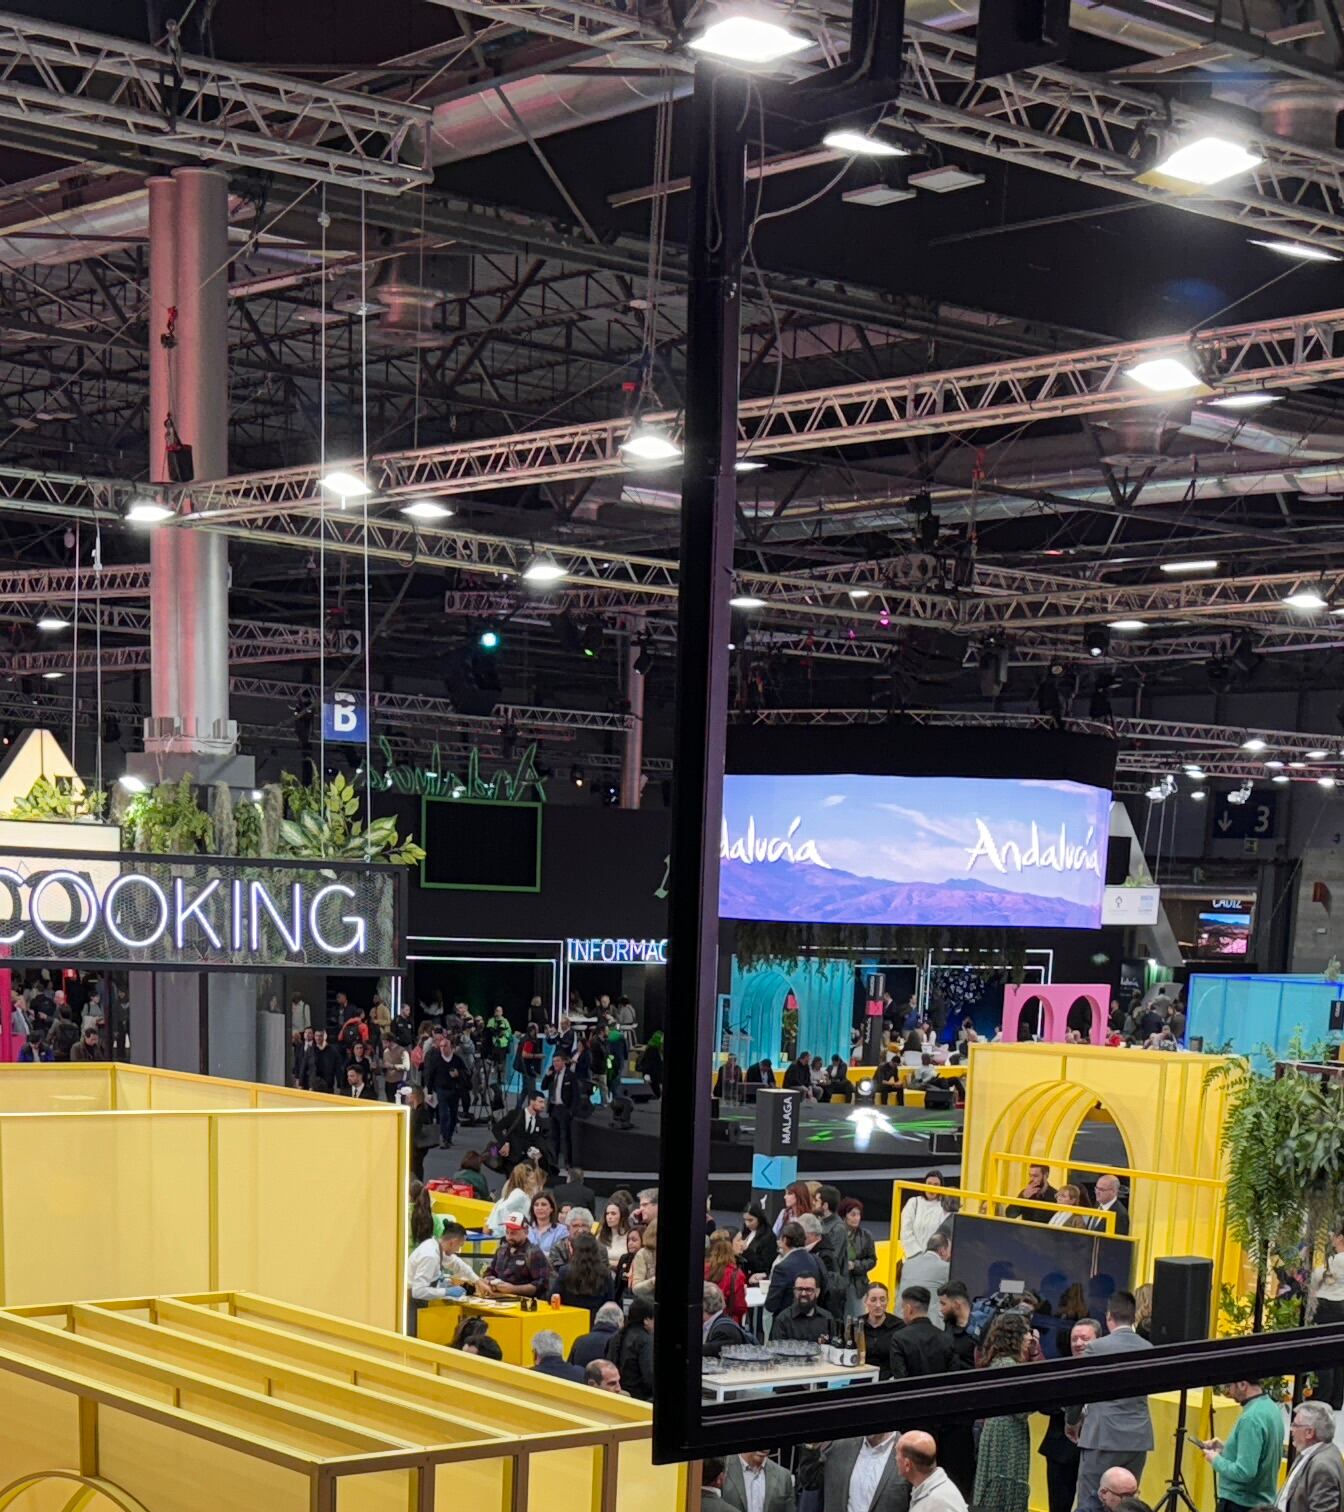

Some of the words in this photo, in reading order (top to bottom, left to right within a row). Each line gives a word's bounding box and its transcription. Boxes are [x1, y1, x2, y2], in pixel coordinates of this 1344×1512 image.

[333, 691, 358, 733] B
[1254, 805, 1271, 834] 3
[964, 817, 1102, 878] Andalucía
